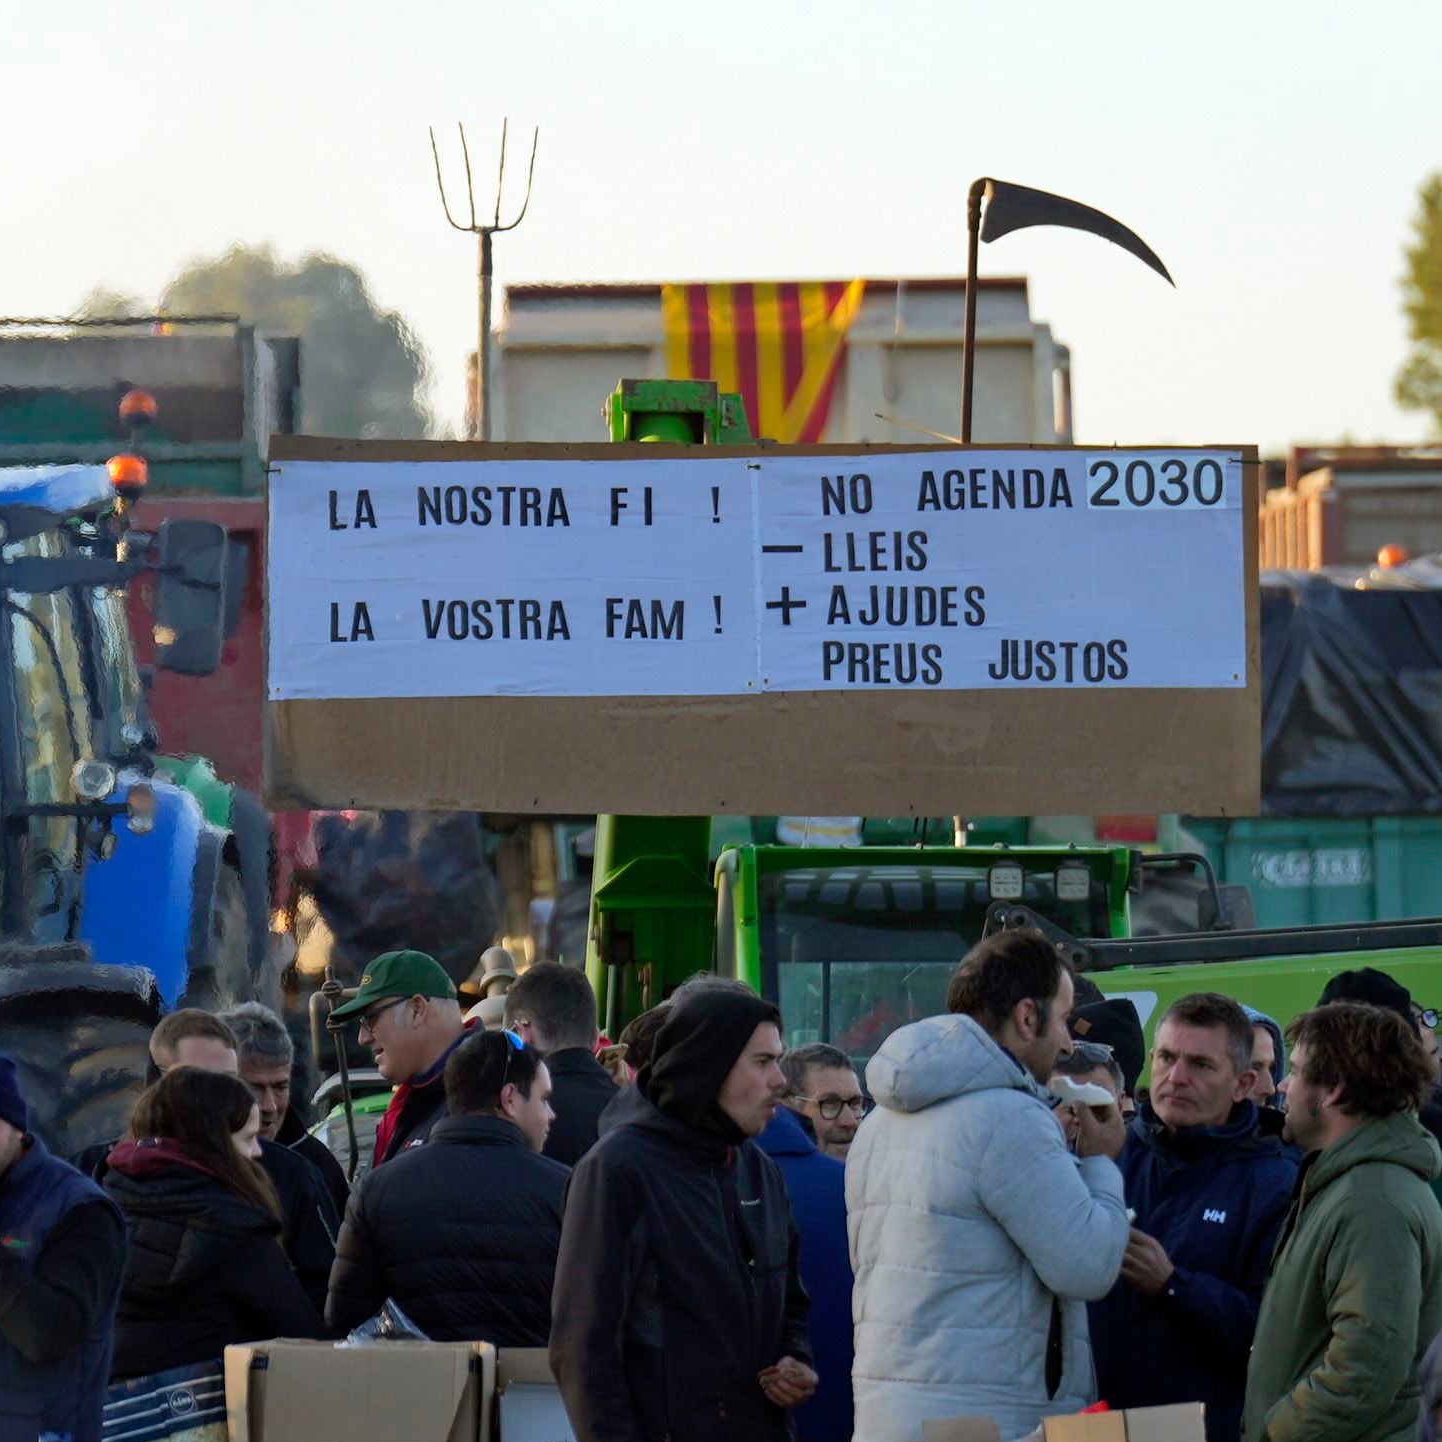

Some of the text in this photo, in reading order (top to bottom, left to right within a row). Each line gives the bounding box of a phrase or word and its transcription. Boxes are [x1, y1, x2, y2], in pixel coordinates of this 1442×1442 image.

[328, 488, 376, 531] LA
[417, 485, 571, 528] NOSTRA
[610, 486, 653, 527] FI
[820, 459, 1223, 516] NO AGENDA 2030
[823, 530, 928, 573] LLEIS
[330, 601, 375, 643] LA
[421, 598, 571, 641] VOSTRA
[605, 597, 685, 641] FAM
[826, 584, 986, 627] AJUDES
[822, 638, 1129, 686] PREUS JUSTOS
